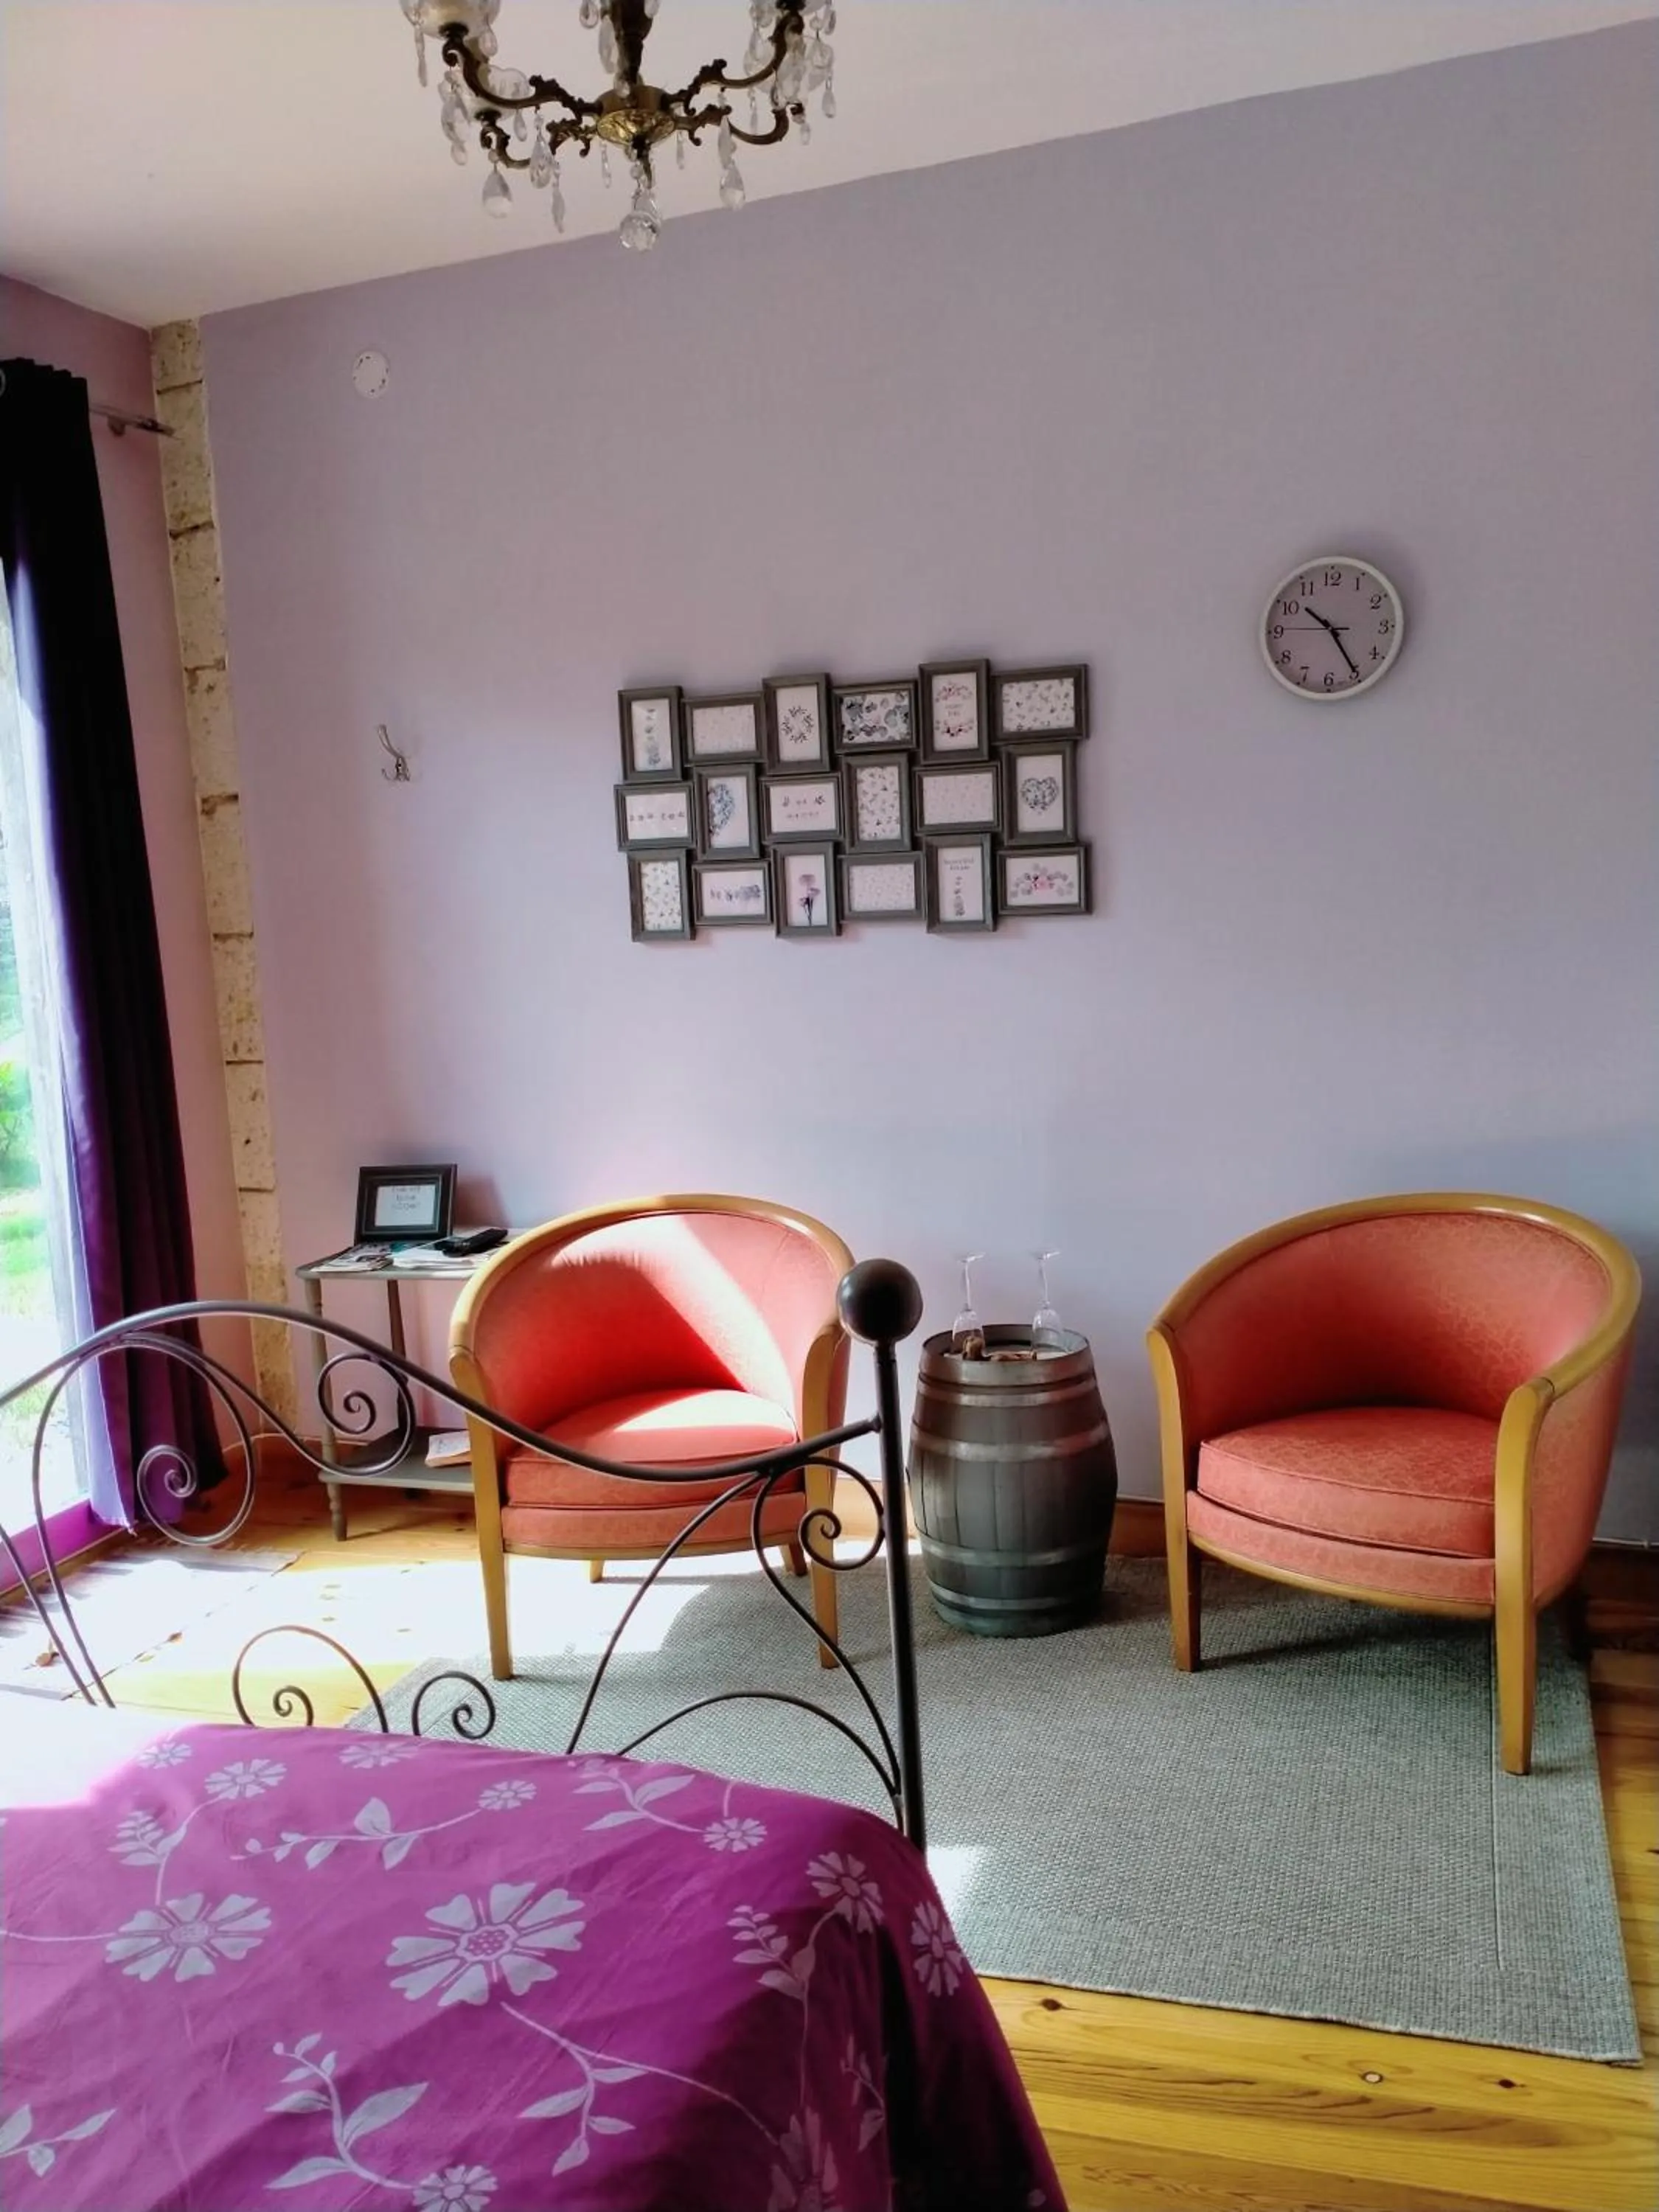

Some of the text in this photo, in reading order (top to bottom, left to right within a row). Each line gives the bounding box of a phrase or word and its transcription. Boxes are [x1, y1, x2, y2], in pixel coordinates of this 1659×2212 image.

[1324, 571, 1342, 586] 12
[1354, 577, 1360, 591] 1
[1301, 581, 1314, 597] 11
[1282, 600, 1300, 616] 10
[1370, 594, 1382, 610] 2
[1273, 625, 1284, 639] 9
[1378, 619, 1389, 635] 3
[1281, 650, 1291, 664] 8
[1369, 644, 1380, 660] 4
[1300, 666, 1310, 683] 7
[1324, 672, 1335, 686] 6
[1349, 664, 1360, 680] 5
